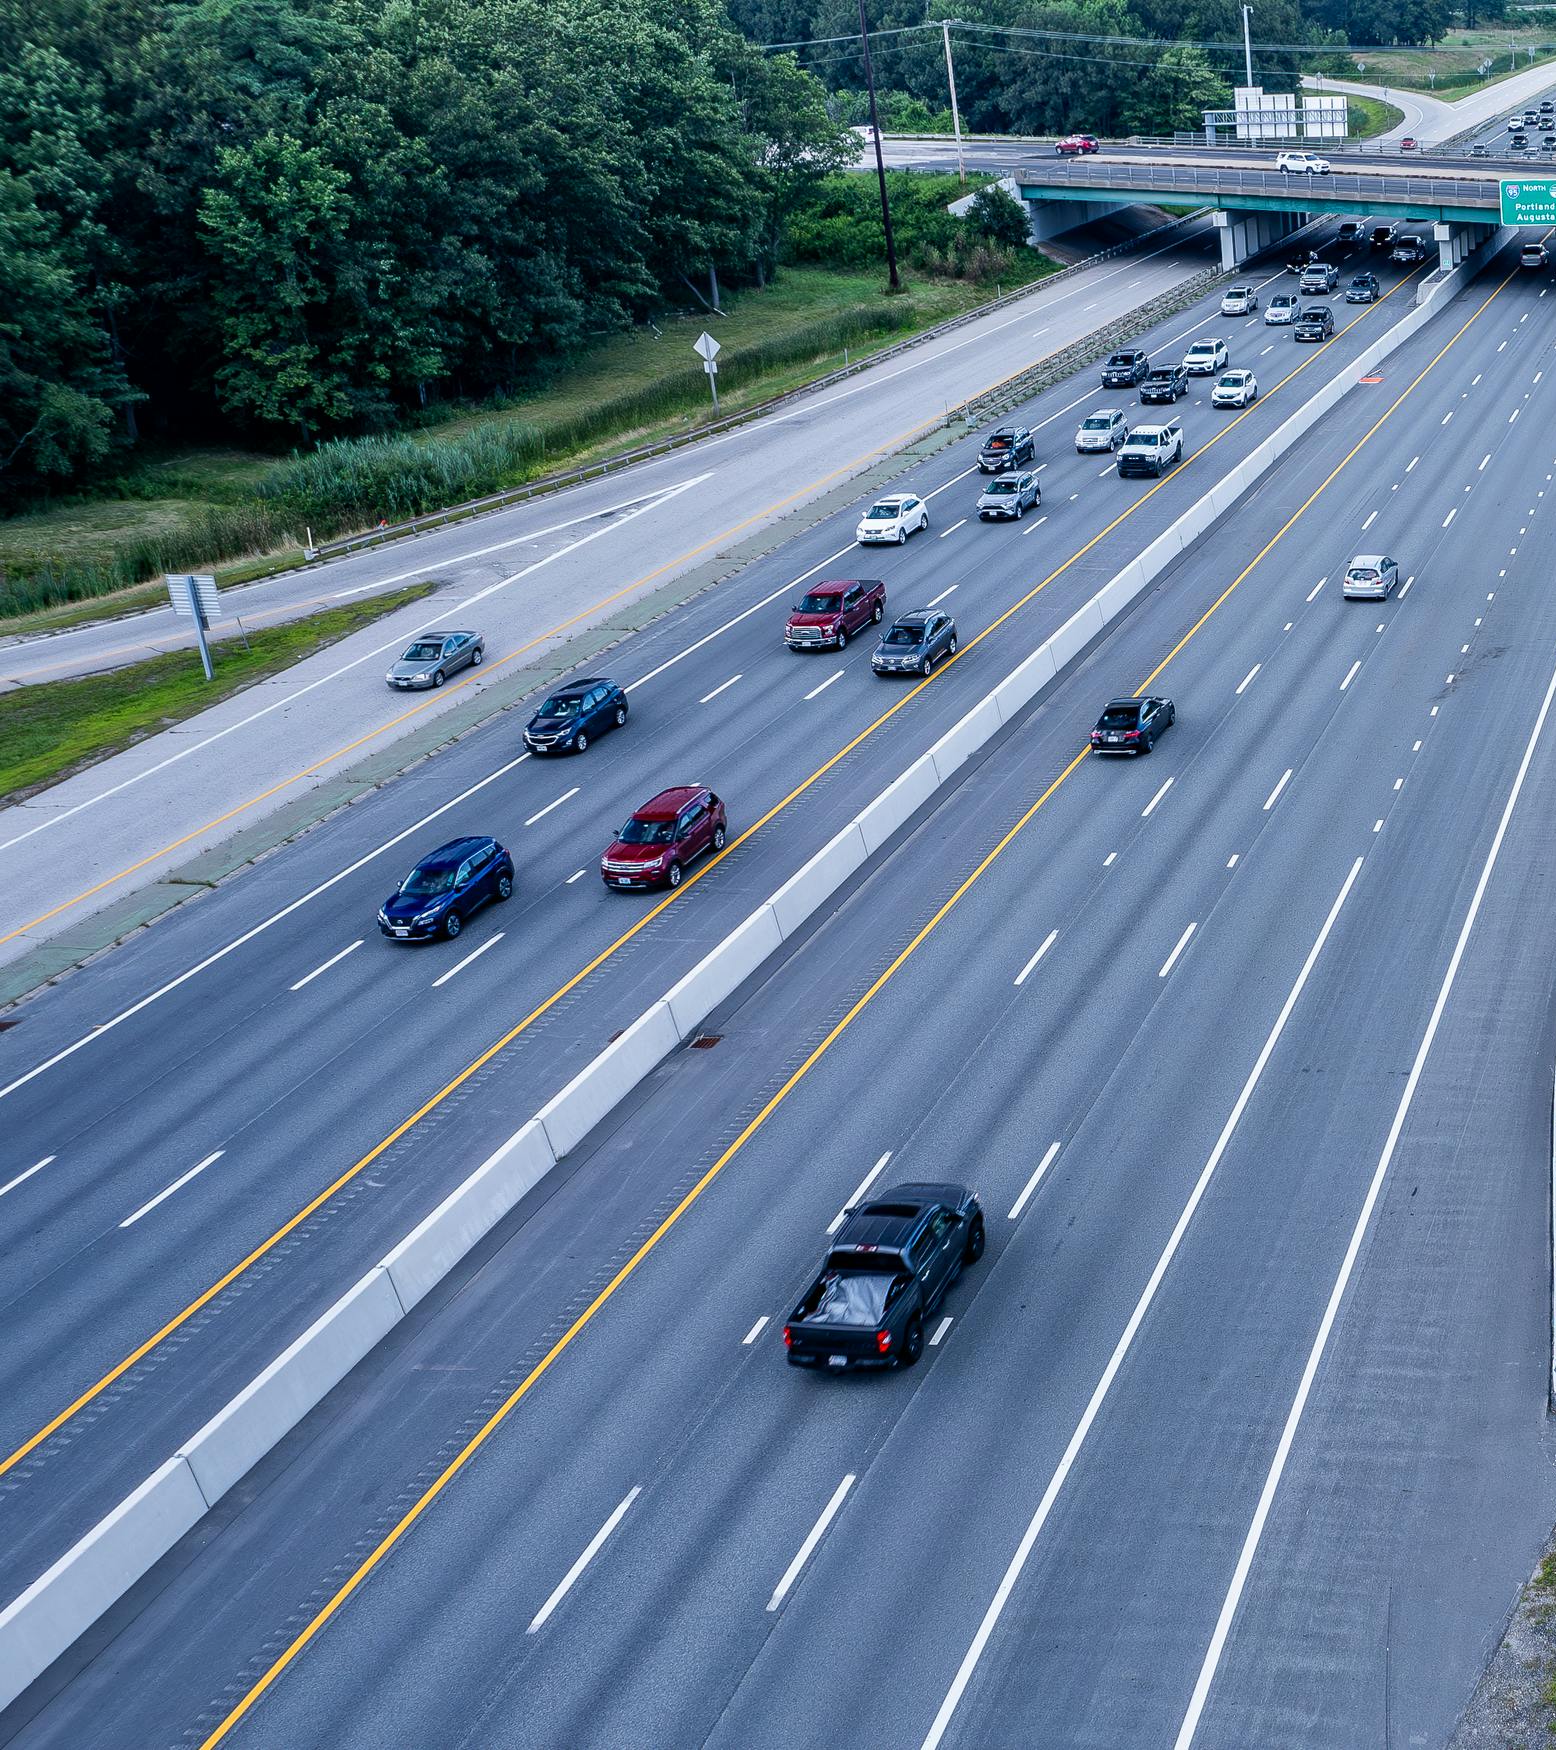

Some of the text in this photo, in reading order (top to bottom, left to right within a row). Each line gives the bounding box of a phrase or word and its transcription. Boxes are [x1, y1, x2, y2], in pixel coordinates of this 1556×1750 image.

[1508, 184, 1547, 197] 95 NORTH
[1515, 203, 1555, 211] Portland
[1516, 213, 1556, 222] Augusta
